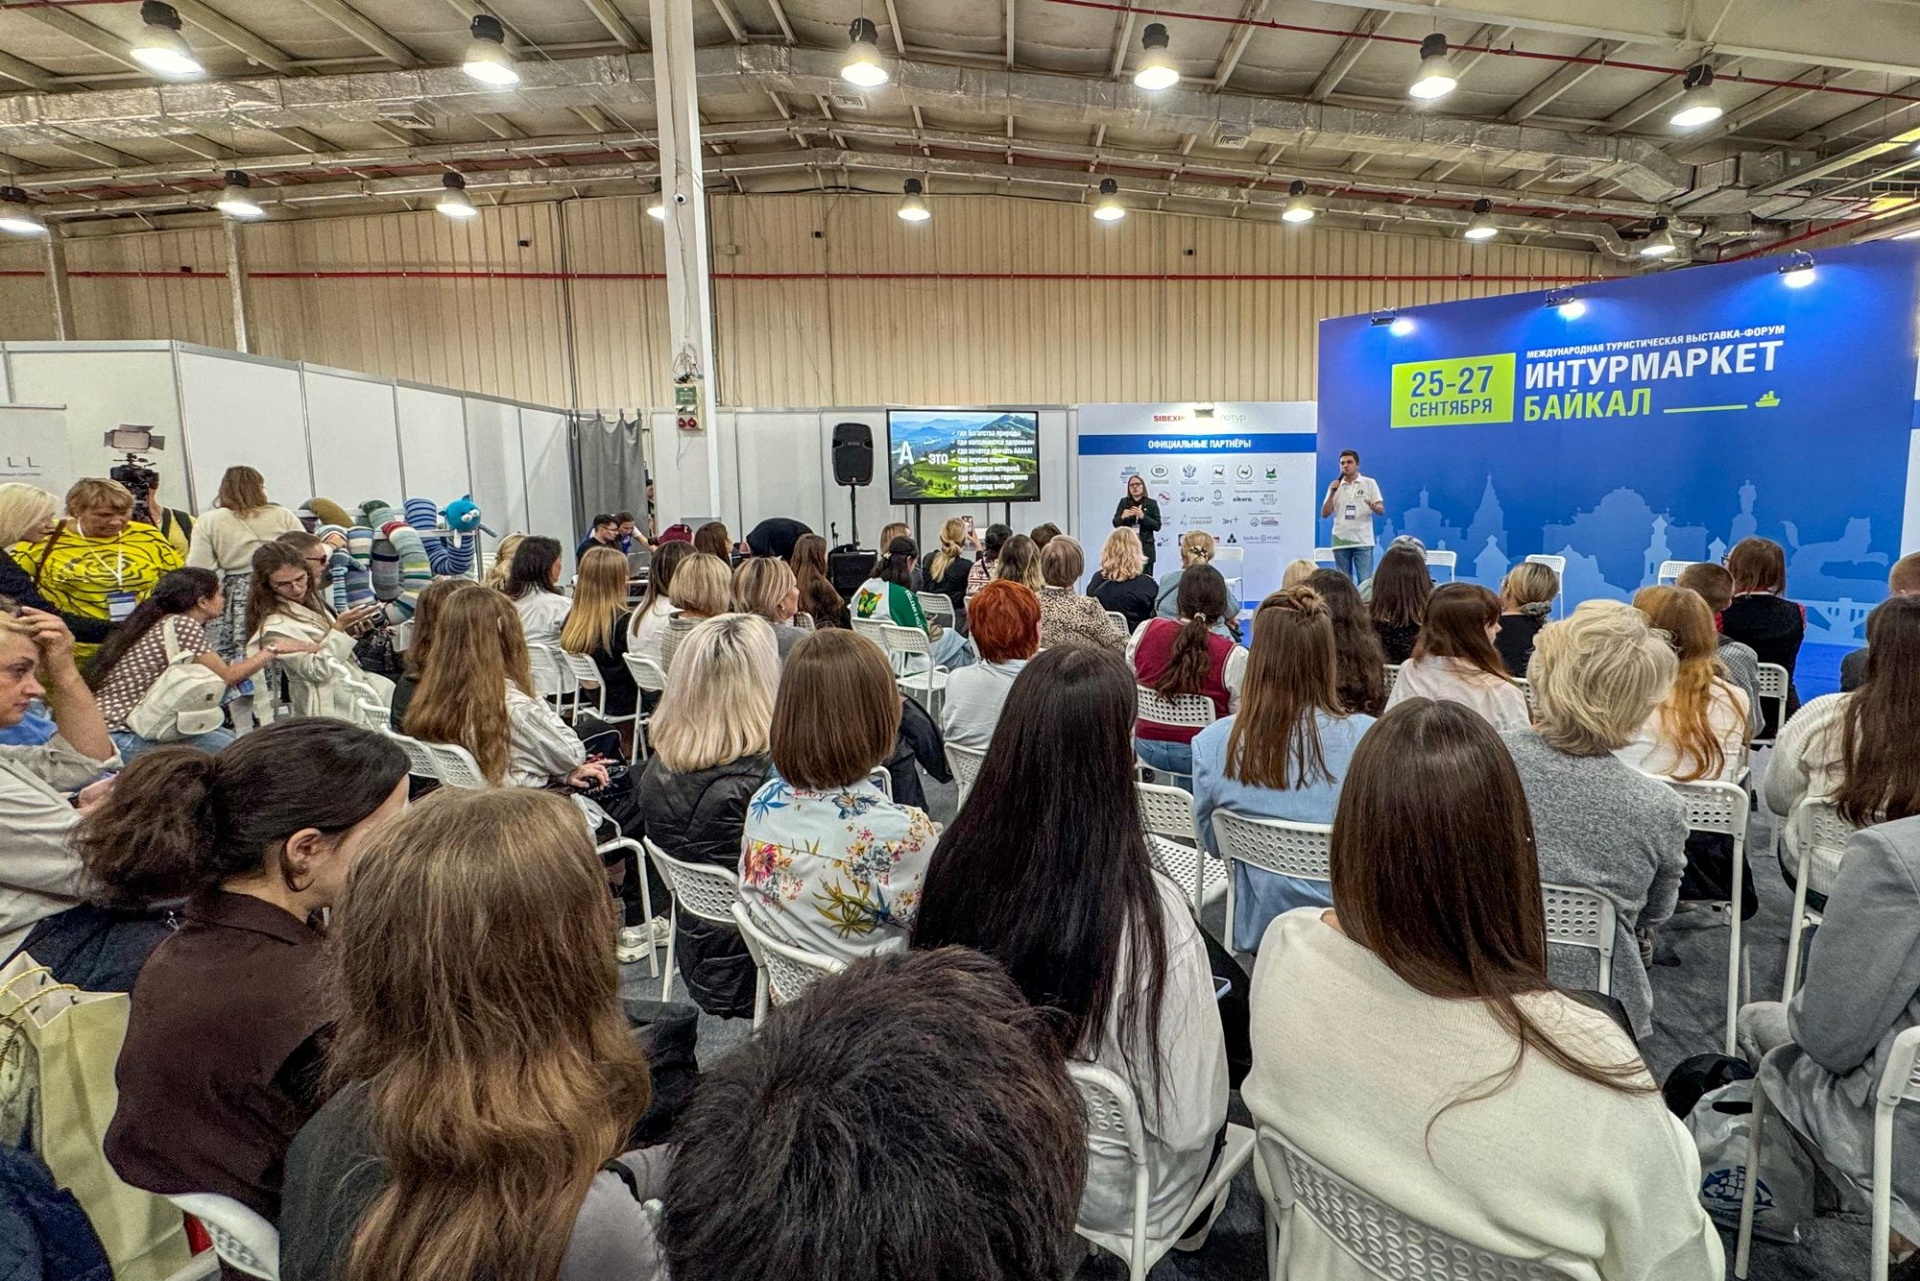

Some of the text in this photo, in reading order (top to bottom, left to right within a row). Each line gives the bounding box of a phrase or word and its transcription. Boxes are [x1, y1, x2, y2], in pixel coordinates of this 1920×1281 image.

[1527, 325, 1785, 359] МЕЖДУНАРОДНАЯ ТУРИСТИЧЕСКАЯ ВЫСТАВКА-ФОРУМ
[1525, 340, 1784, 389] ИНТУРМАРКЕТ
[1411, 366, 1494, 398] 25-27
[1410, 398, 1492, 417] СЕНТЯБРЯ
[1524, 388, 1651, 422] БАЙКАЛ
[899, 441, 914, 465] А
[1148, 438, 1251, 450] ОФИЦИАЛЬНЫЕ ПАРТНЁРЫ
